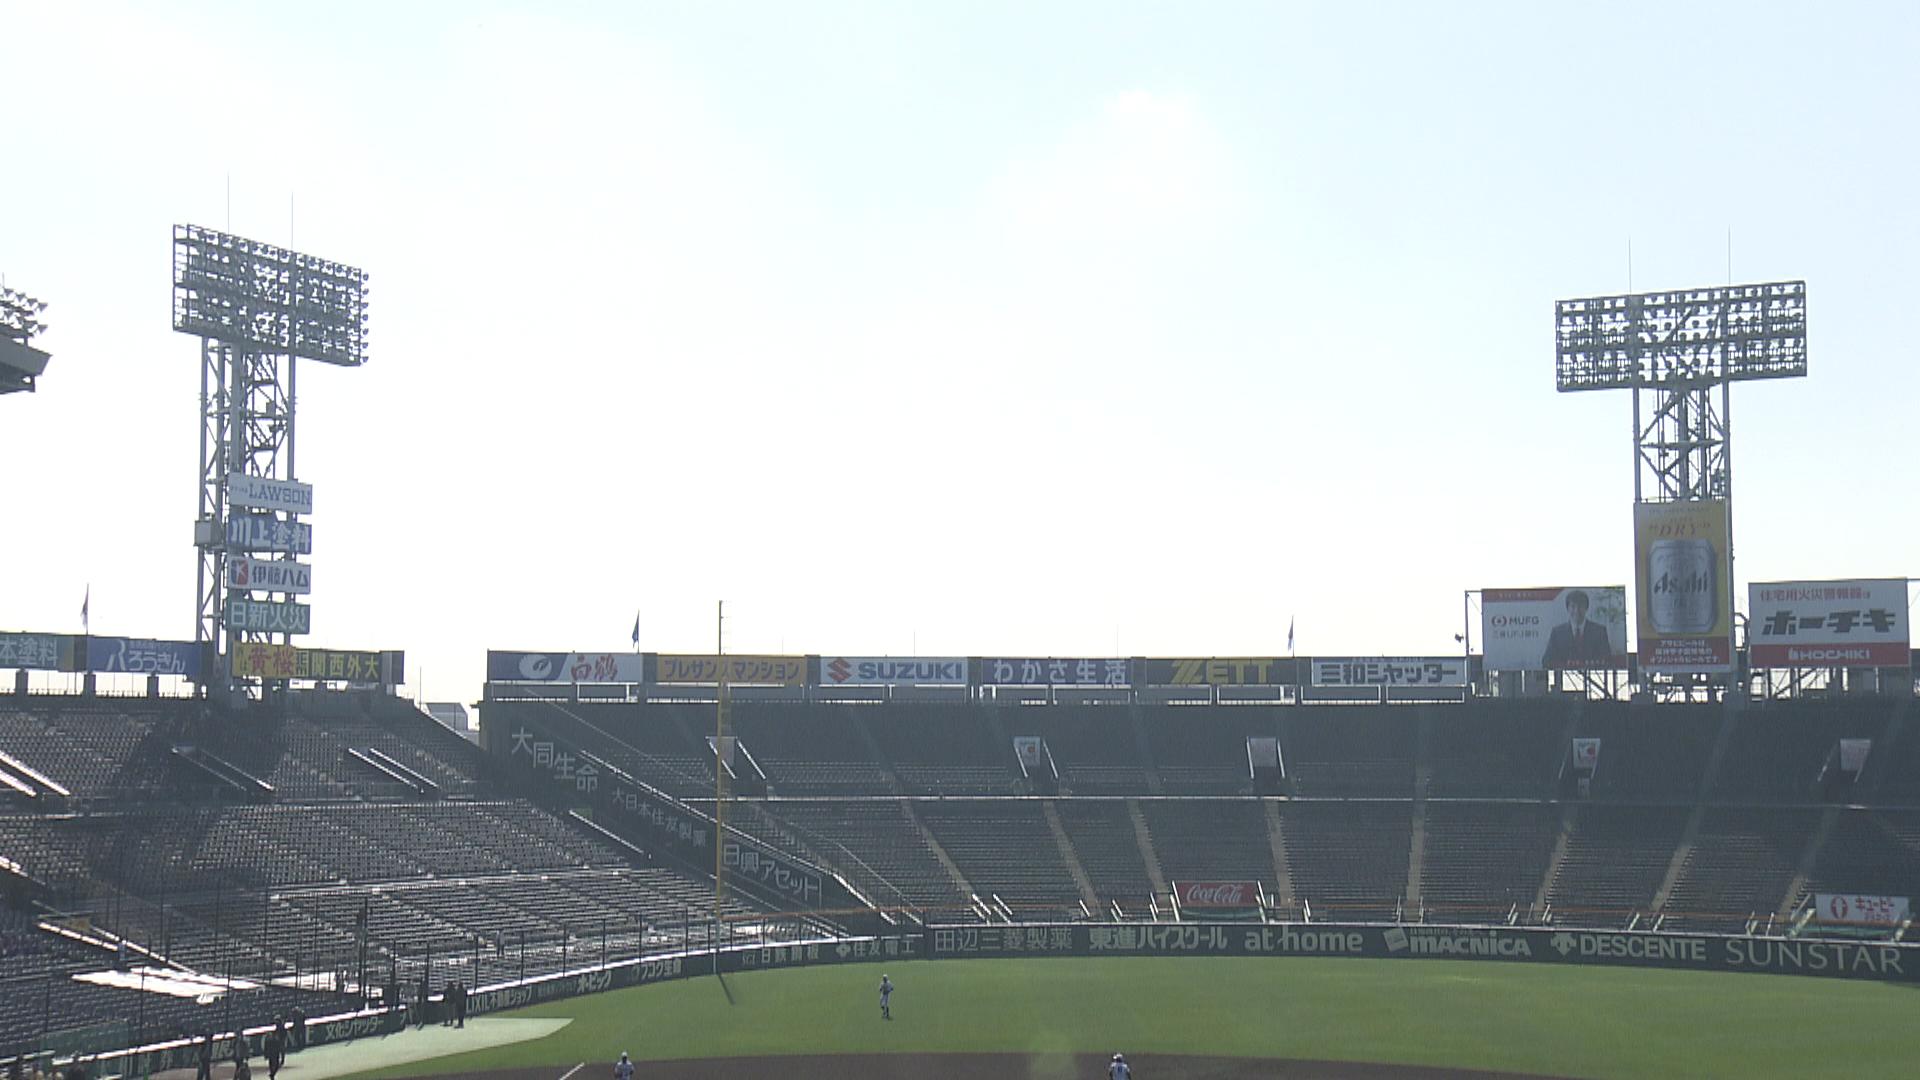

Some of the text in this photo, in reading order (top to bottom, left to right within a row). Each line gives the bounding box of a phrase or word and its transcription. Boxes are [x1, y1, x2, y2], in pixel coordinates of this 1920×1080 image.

[249, 483, 311, 505] LAWSON
[231, 517, 310, 553] 川上塗料
[252, 565, 309, 587] 伊藤ハム
[1653, 569, 1708, 594] Asahi
[231, 602, 307, 630] 日新火災
[1508, 616, 1540, 625] MUFG
[1762, 608, 1896, 636] ホーチキ
[128, 650, 186, 673] ろうきん
[1801, 649, 1871, 660] HOCHIKI
[858, 661, 963, 680] SUZUKI
[993, 658, 1127, 685] わかさ生活
[1169, 659, 1275, 684] ZETT
[1320, 662, 1457, 685] 三和シャッター
[511, 726, 600, 793] 大同生命
[612, 786, 706, 848] 大日本住友製薬
[723, 844, 819, 901] 日興アセット
[853, 940, 915, 957] 住友電工
[934, 927, 1073, 952] 田辺三菱製薬
[1089, 925, 1229, 952] 東進ハイスクール
[1579, 934, 1707, 961] DESCENTE
[1725, 938, 1904, 974] SUNSTAR
[325, 1016, 385, 1041] 文化シャッター
